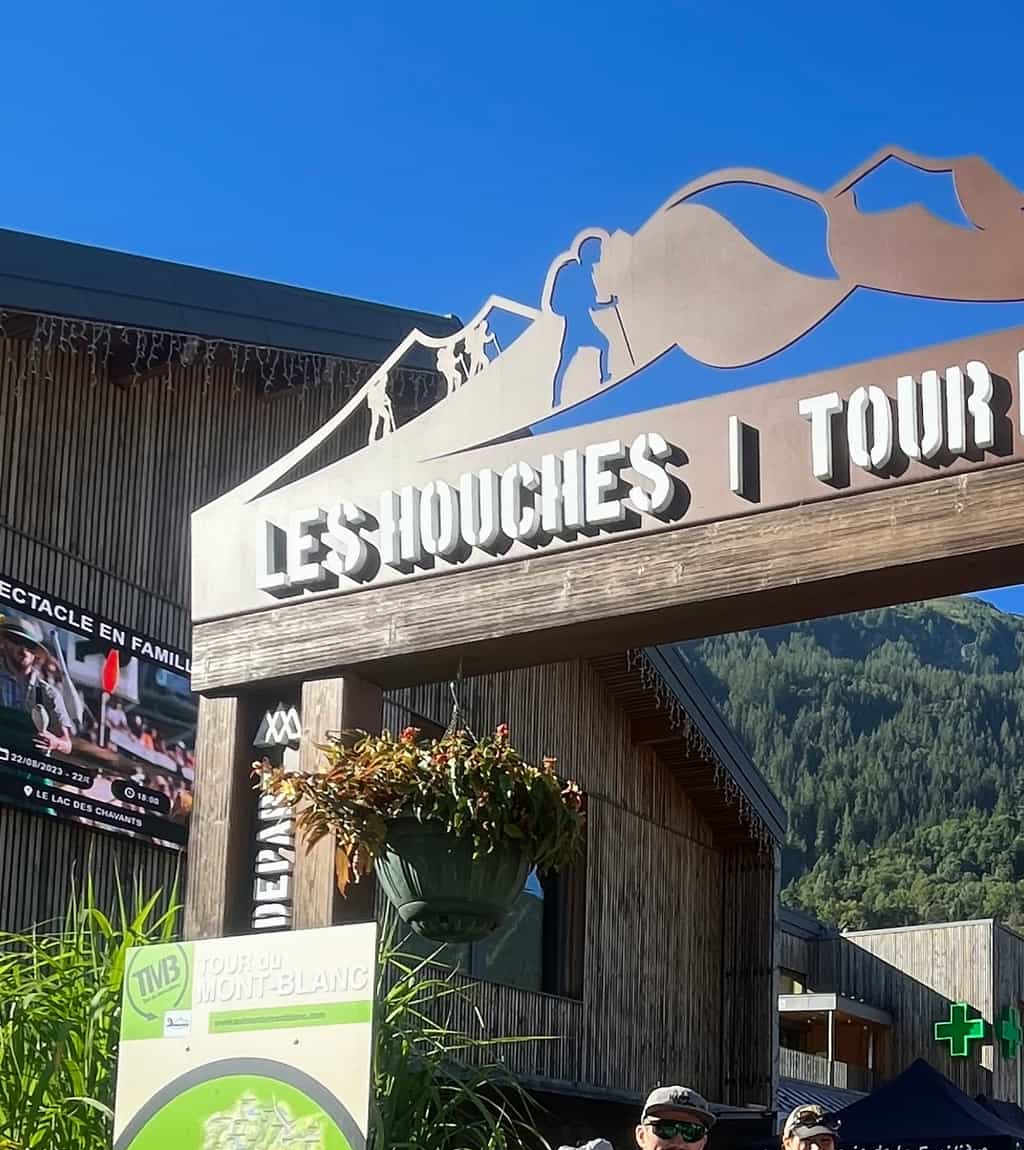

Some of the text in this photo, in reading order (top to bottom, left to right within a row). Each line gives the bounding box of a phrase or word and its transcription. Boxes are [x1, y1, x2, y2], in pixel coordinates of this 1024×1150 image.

[256, 501, 376, 594] LES
[381, 431, 676, 569] HOUCHES
[798, 360, 995, 482] TOUR
[99, 622, 126, 646] EN
[11, 752, 64, 776] 22/08/2023
[36, 789, 143, 828] LE LAC DES CHAVANTS
[251, 792, 297, 929] DEPAR
[132, 954, 180, 998] TMB
[201, 951, 283, 976] TOUR du
[197, 964, 370, 1005] MONT-BLANC
